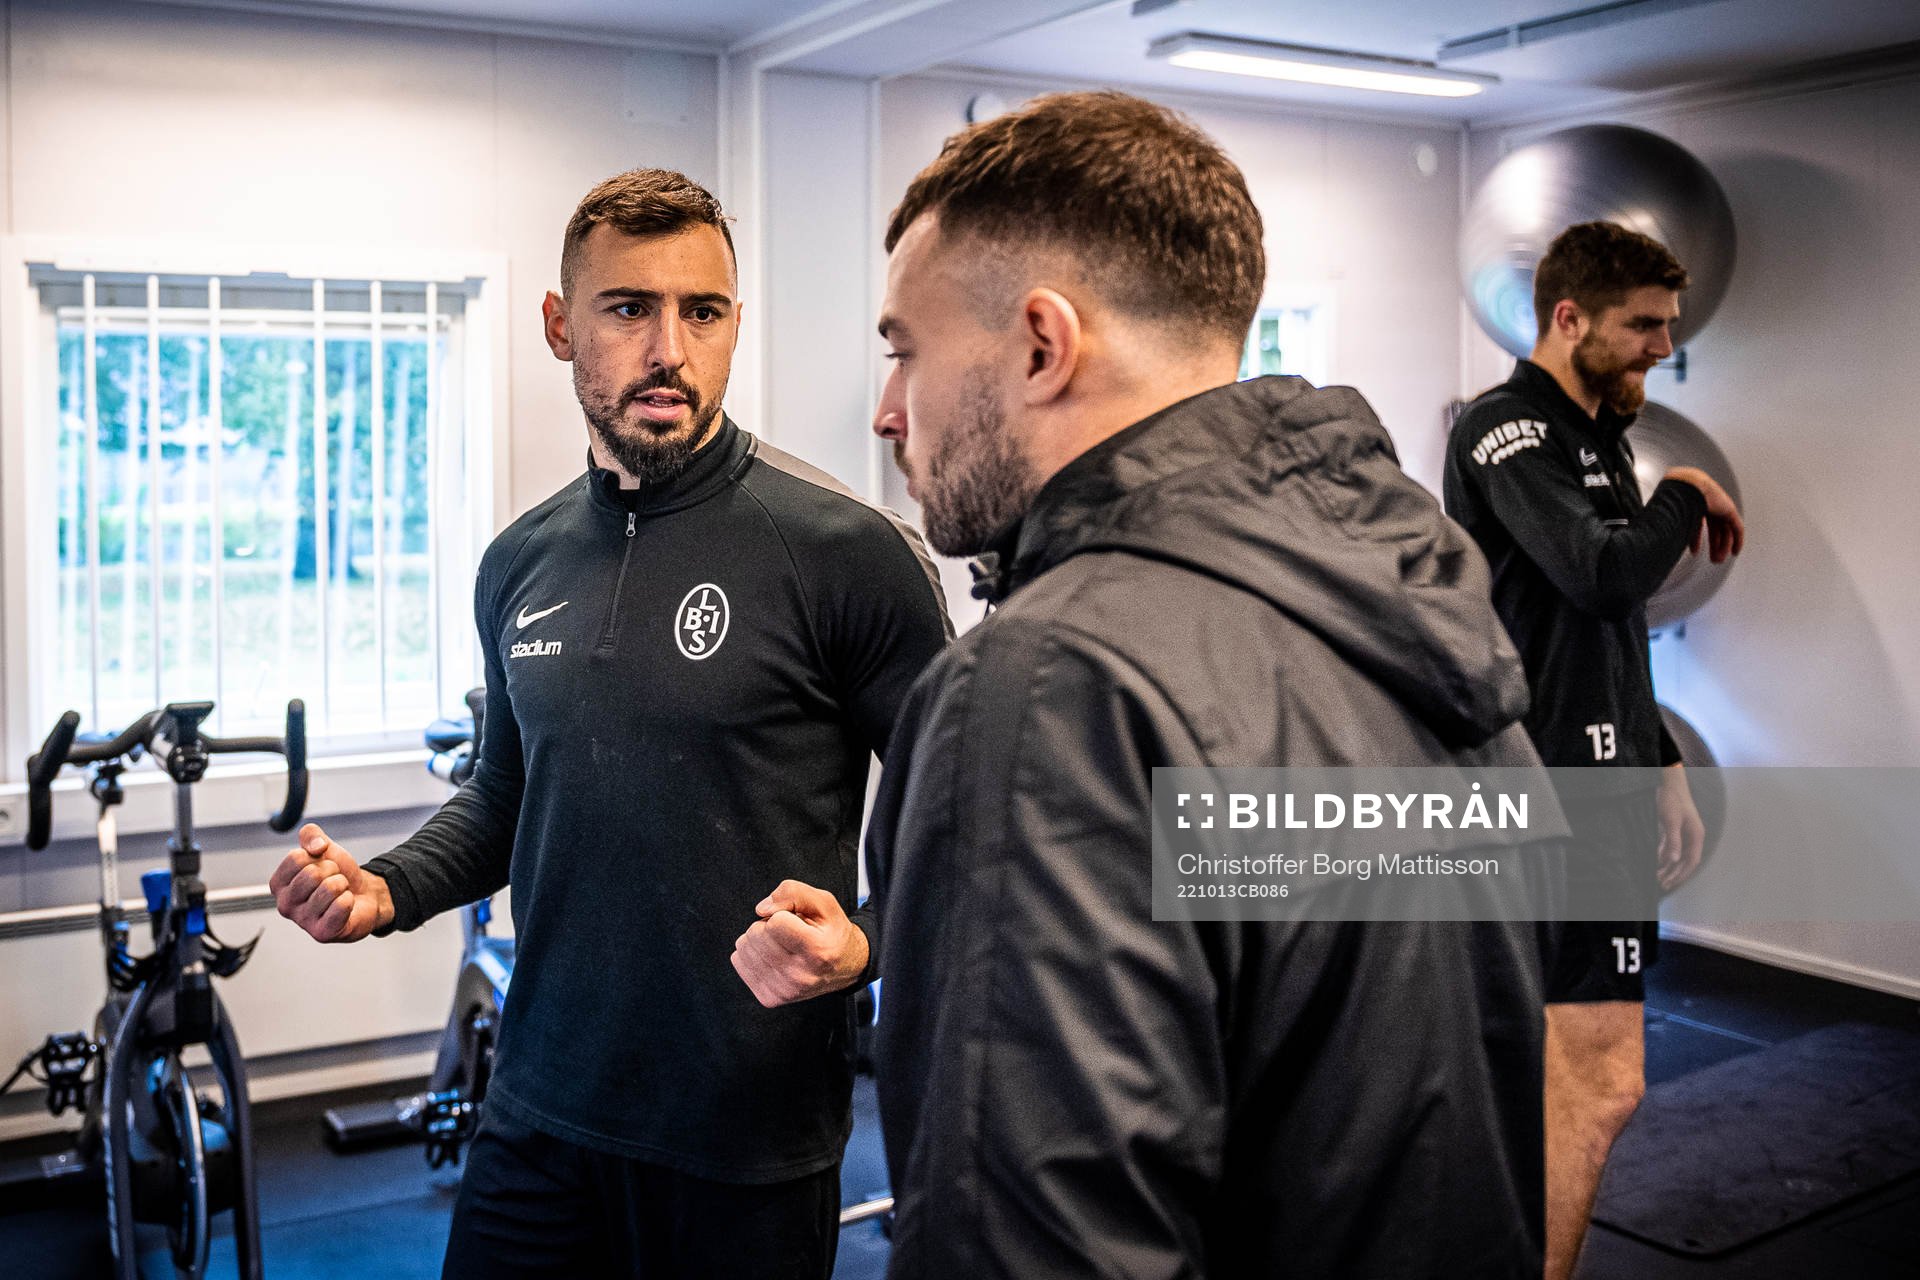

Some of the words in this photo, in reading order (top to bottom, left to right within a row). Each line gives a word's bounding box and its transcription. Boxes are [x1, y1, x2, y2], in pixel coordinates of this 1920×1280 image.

[1472, 419, 1548, 466] UNIBET
[510, 639, 563, 658] stadium
[1586, 723, 1616, 760] 13
[1612, 937, 1641, 973] 13
